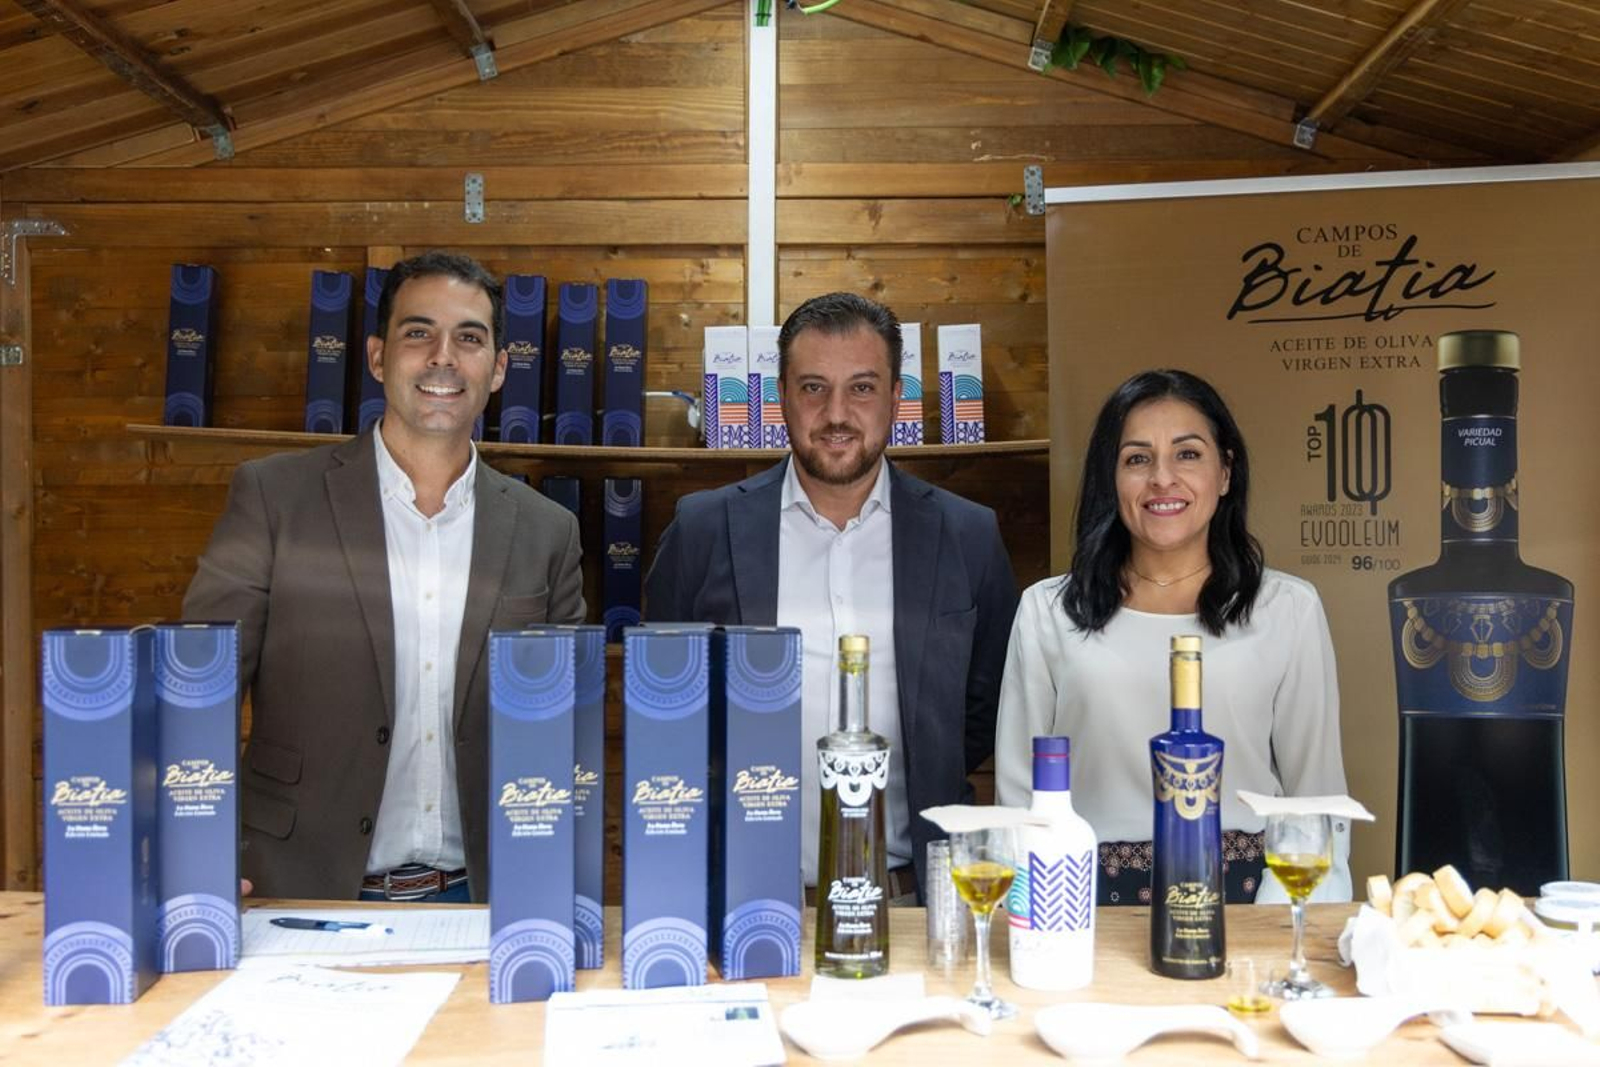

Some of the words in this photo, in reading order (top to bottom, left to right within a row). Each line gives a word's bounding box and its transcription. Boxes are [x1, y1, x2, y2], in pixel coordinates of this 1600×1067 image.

[1296, 223, 1398, 244] CAMPOS
[1337, 244, 1362, 258] DE
[1227, 234, 1496, 321] Biatia
[1270, 336, 1335, 352] ACEITE
[1343, 336, 1367, 350] DE
[1375, 334, 1433, 349] OLIVA
[1281, 356, 1351, 372] VIRGEN
[1360, 355, 1421, 370] EXTRA
[1307, 425, 1322, 462] TOP
[1457, 427, 1503, 438] VARIEDAD
[1463, 437, 1497, 447] PICUAL
[1300, 503, 1338, 517] AWARDS
[1340, 503, 1364, 517] 2023
[1300, 519, 1400, 548] EVOOLEUM
[1351, 554, 1401, 571] 96/100
[163, 763, 235, 787] Biatia
[732, 768, 800, 793] Biatia
[51, 780, 127, 807] Biatia
[498, 780, 572, 807] Biatia
[632, 779, 704, 805] Biatia
